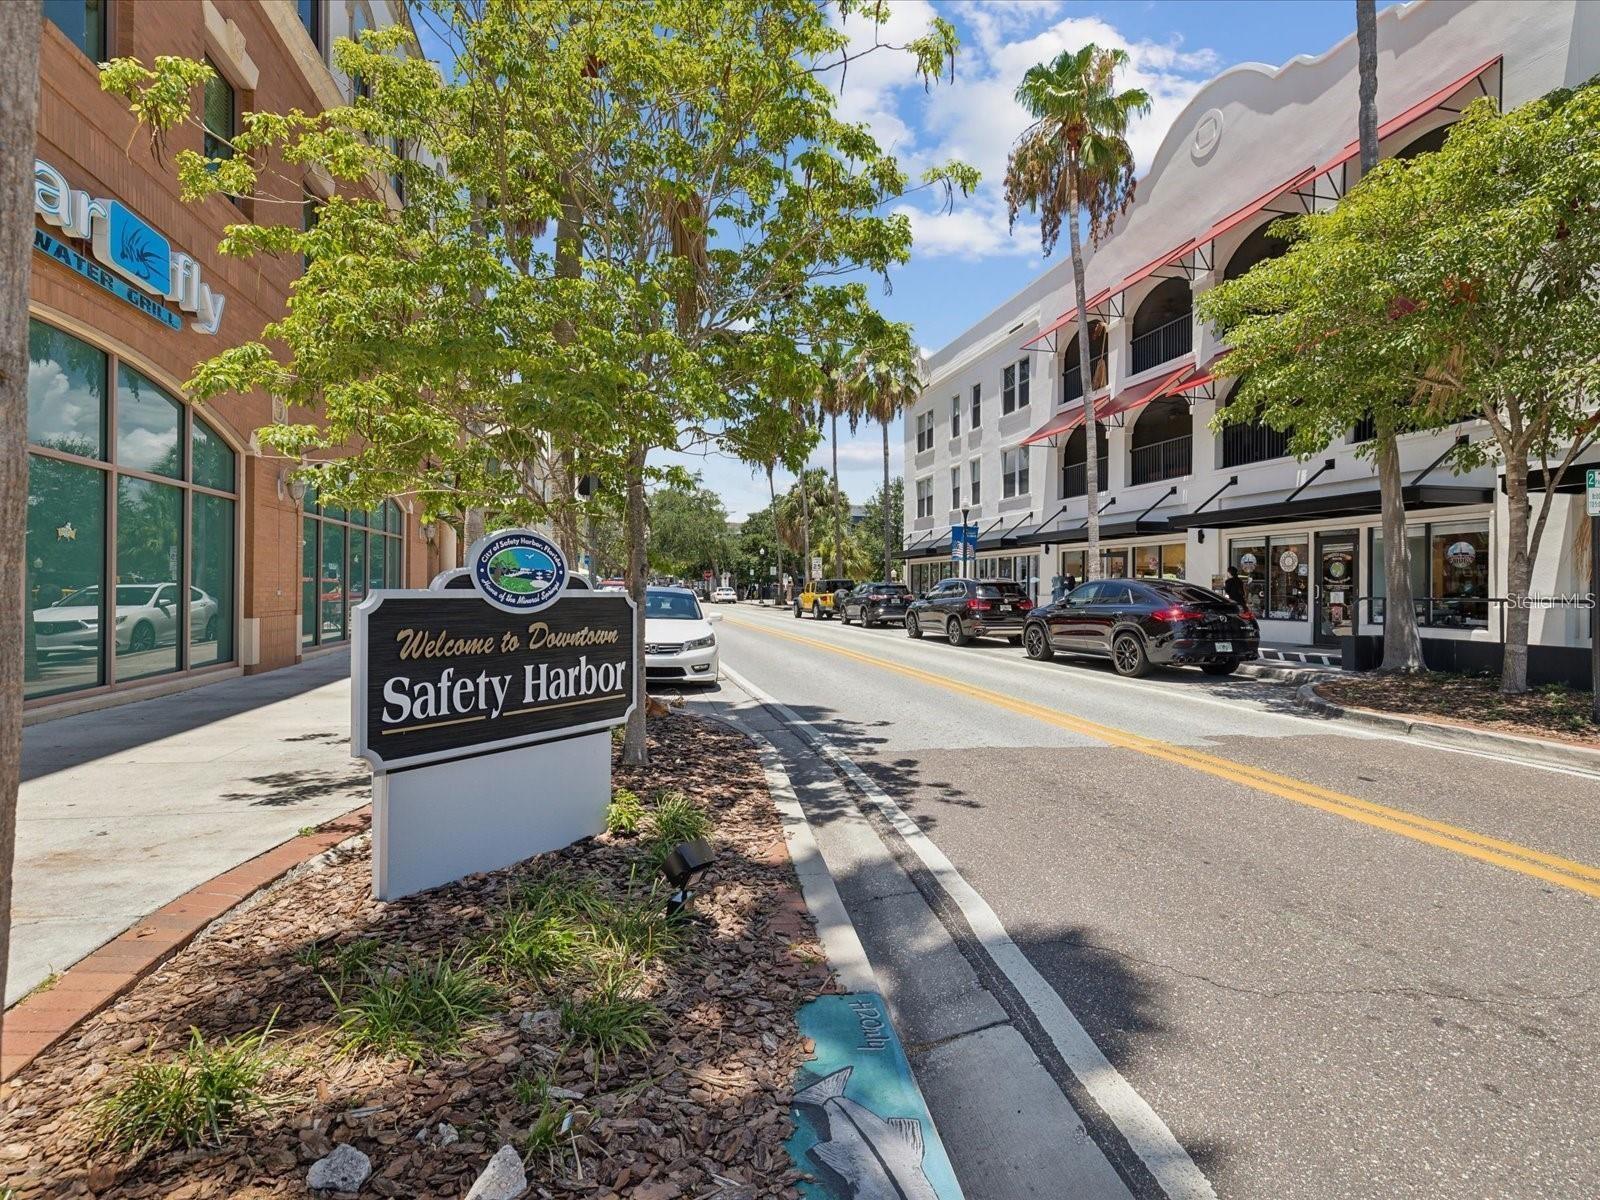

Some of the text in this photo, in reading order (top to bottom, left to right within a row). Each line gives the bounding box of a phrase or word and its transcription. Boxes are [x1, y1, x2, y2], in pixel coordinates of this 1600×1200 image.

[127, 287, 179, 331] GRILL
[481, 547, 493, 564] City
[493, 543, 500, 551] of
[500, 537, 520, 548] Safety
[544, 545, 562, 567] Florida
[481, 578, 560, 605] Home of the Mineral Springs
[397, 621, 619, 661] Welcome to Downtown
[381, 655, 626, 724] Safety Harbor
